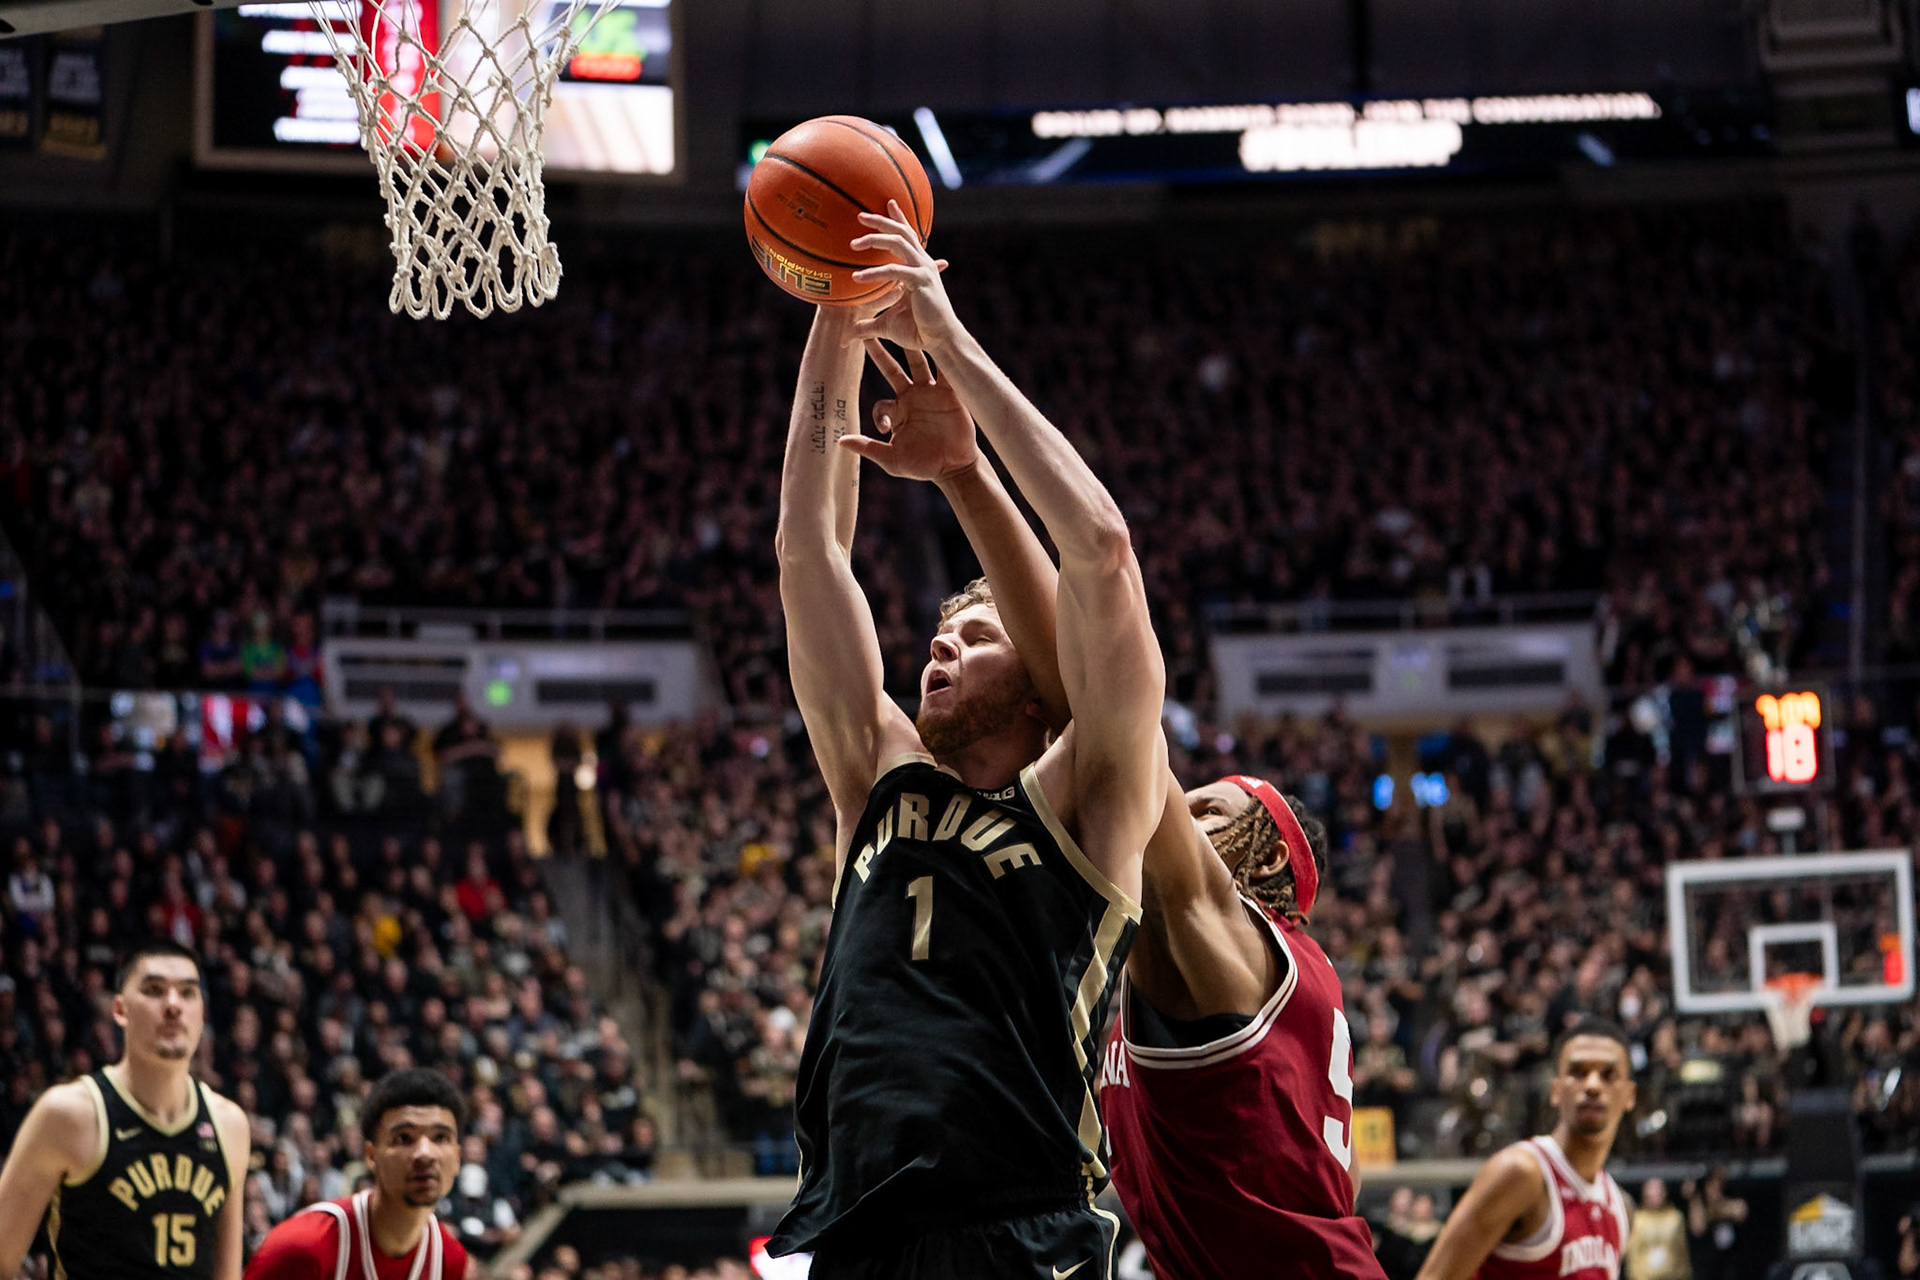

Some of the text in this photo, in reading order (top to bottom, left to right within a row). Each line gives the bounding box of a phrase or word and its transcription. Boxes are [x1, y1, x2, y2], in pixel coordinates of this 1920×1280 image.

[853, 792, 1043, 884] PURDUE
[905, 875, 934, 961] 1
[108, 1152, 226, 1218] PURDUE
[153, 1212, 197, 1267] 15
